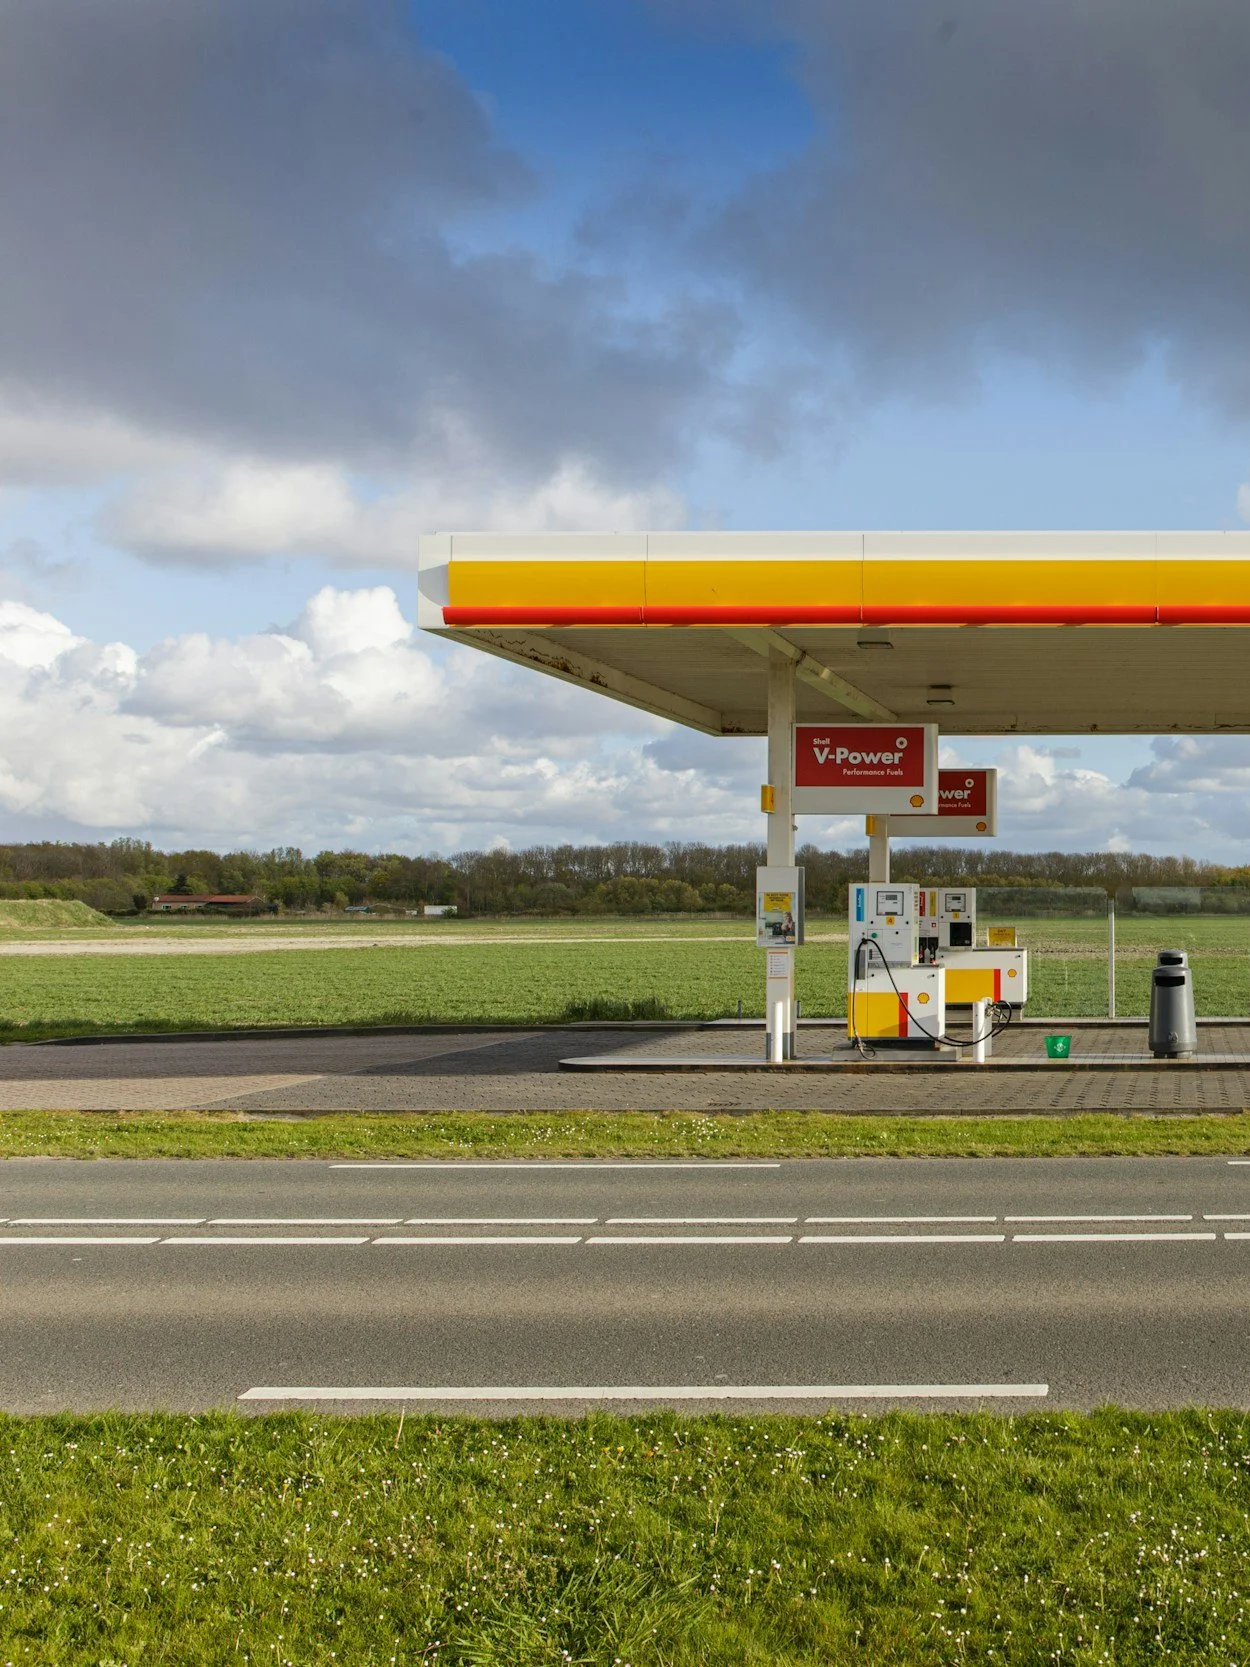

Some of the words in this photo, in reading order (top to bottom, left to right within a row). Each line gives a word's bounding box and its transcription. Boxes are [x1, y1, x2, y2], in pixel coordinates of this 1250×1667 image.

[813, 747, 902, 764] V-Power
[843, 768, 885, 776] Performance
[886, 768, 903, 776] Fuels
